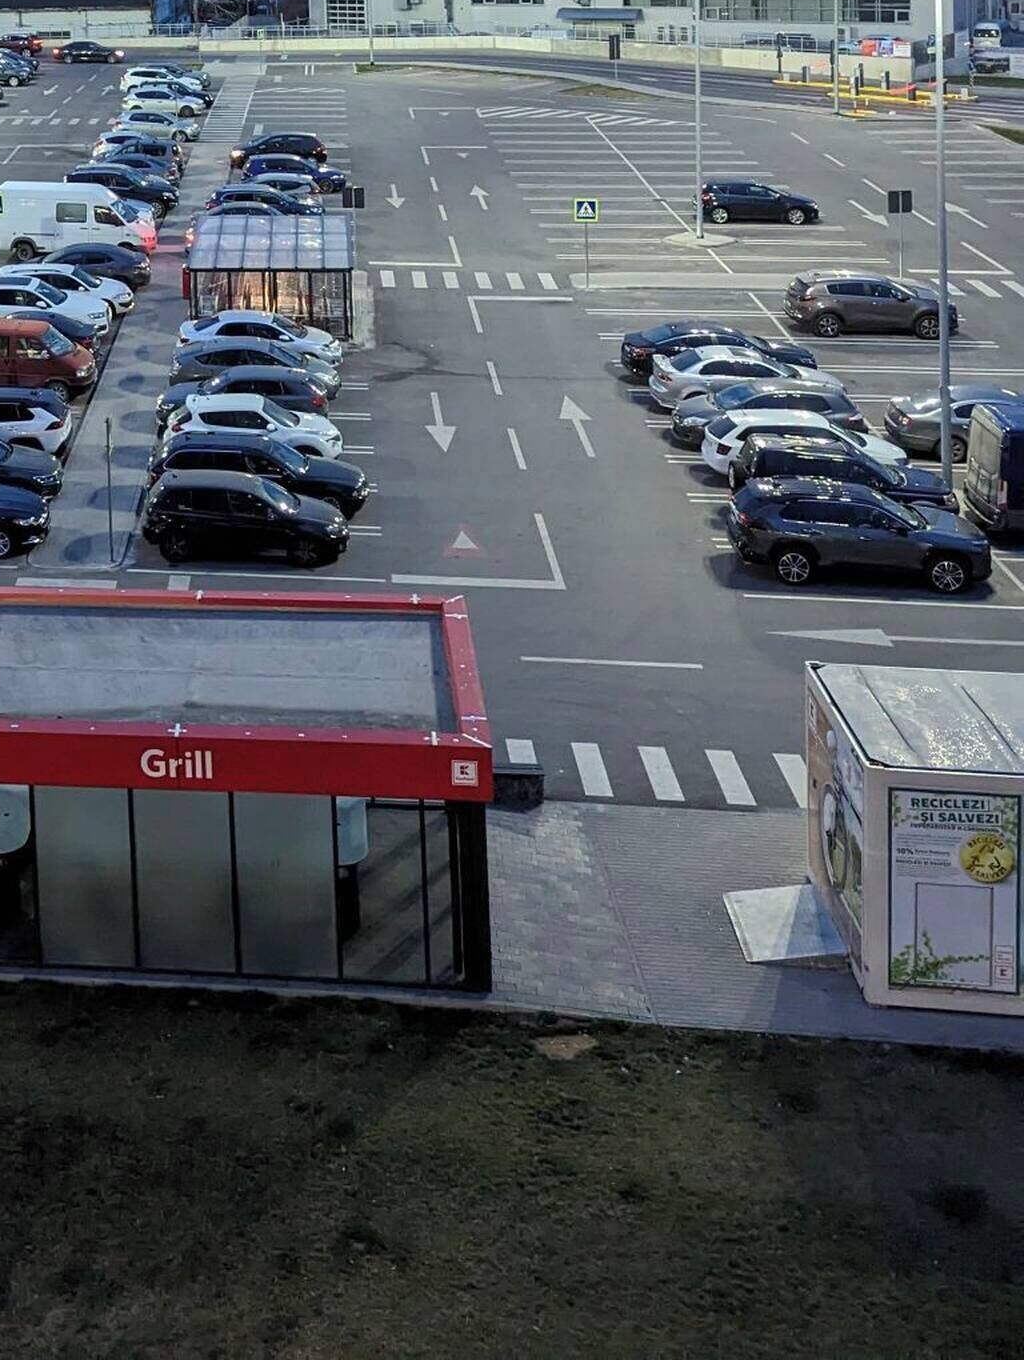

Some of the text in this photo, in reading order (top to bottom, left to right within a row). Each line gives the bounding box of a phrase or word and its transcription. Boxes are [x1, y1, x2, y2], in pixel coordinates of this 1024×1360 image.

[140, 748, 213, 779] Grill
[911, 798, 985, 810] RECICLEZI
[938, 813, 1000, 824] SALVEZI
